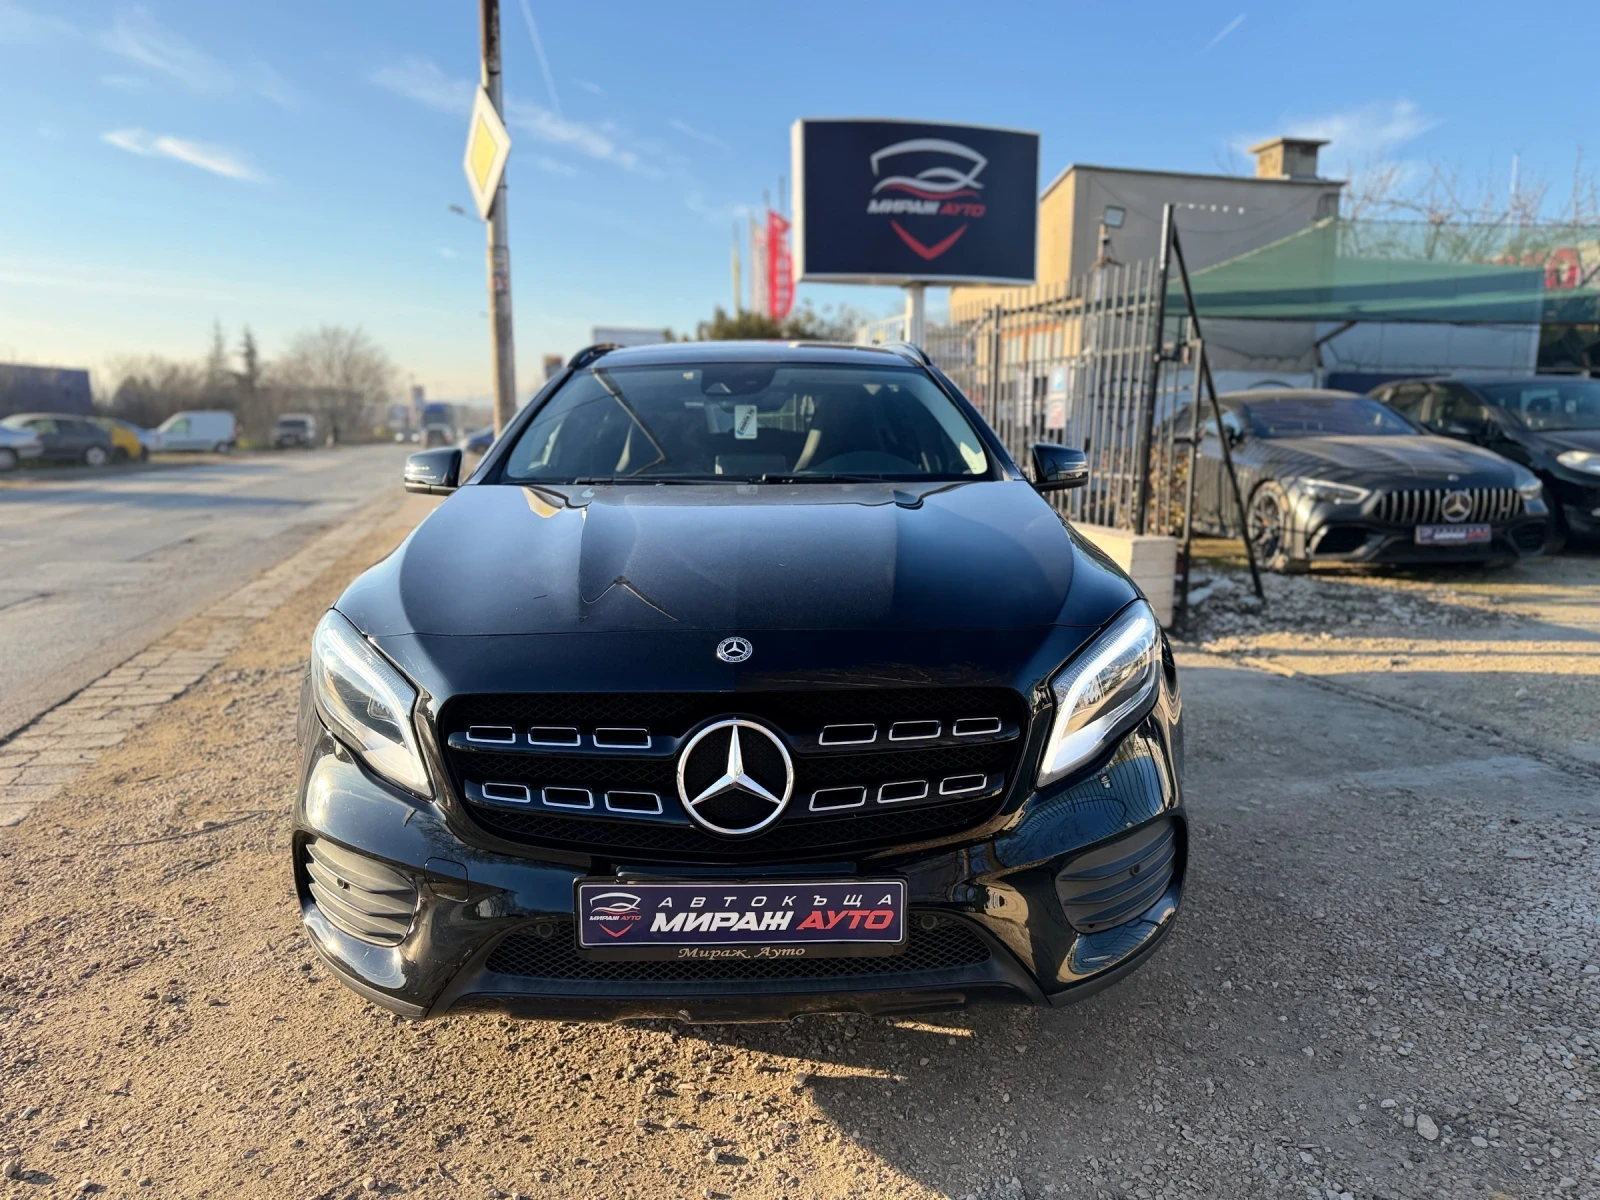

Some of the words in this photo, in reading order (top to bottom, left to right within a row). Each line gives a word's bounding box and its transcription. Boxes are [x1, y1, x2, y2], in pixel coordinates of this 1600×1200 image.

[657, 894, 892, 908] АВТОКЪЩА
[650, 910, 794, 932] МИРАЖ
[796, 909, 895, 931] АУТО
[678, 947, 751, 960] Мираж
[754, 947, 806, 959] Ауто
